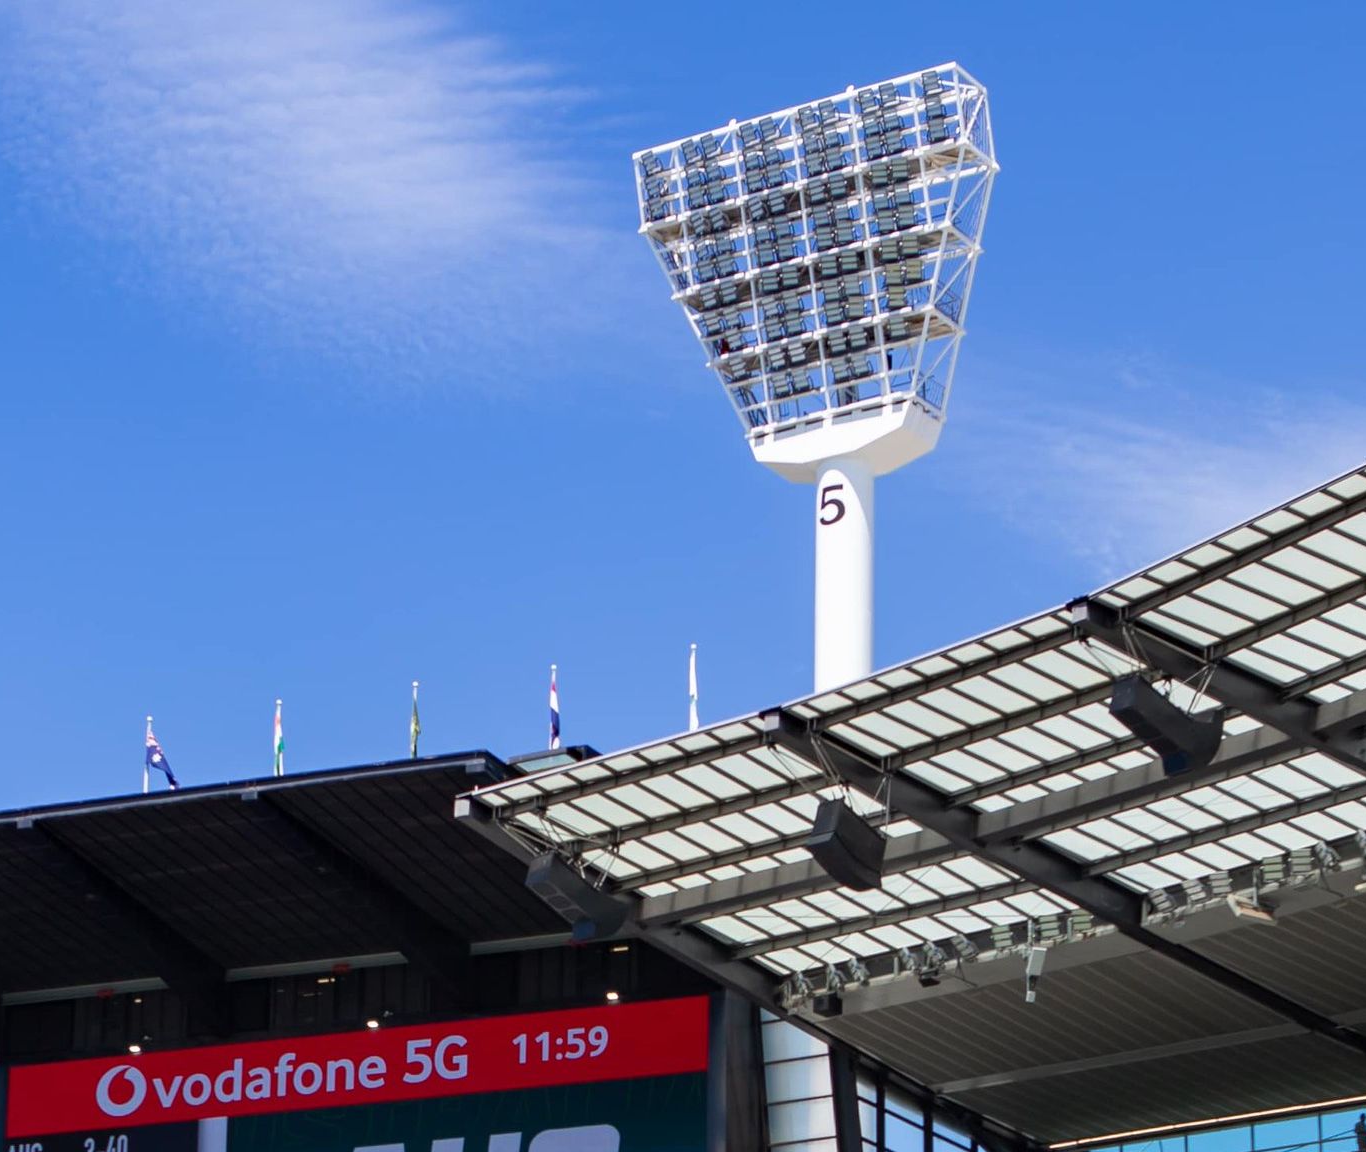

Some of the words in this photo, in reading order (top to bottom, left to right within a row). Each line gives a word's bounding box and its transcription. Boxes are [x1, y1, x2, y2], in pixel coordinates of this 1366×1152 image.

[820, 484, 846, 526] 5
[512, 1026, 609, 1064] 11:59
[153, 1052, 386, 1109] vodafone
[402, 1035, 469, 1084] 5G
